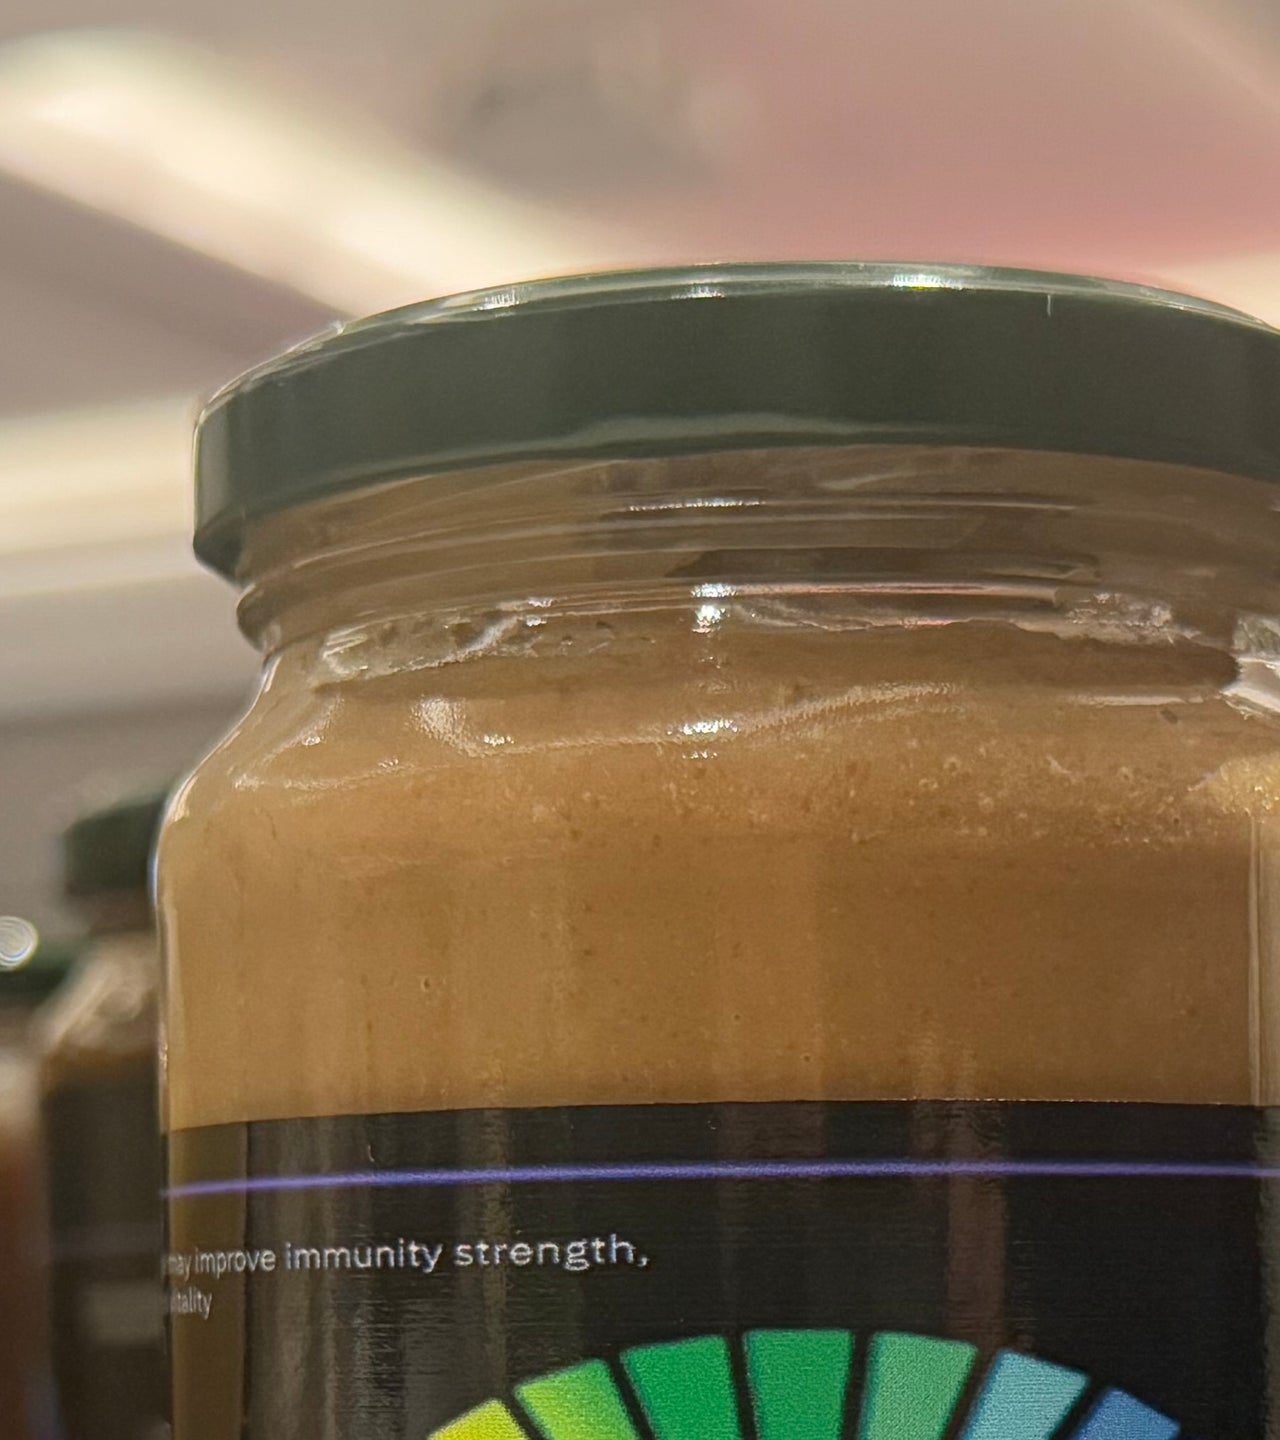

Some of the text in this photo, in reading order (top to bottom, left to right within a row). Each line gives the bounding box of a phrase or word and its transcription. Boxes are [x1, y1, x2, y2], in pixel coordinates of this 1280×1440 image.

[195, 1246, 276, 1280] improve
[285, 1237, 443, 1273] immunity
[453, 1234, 650, 1271] strength,
